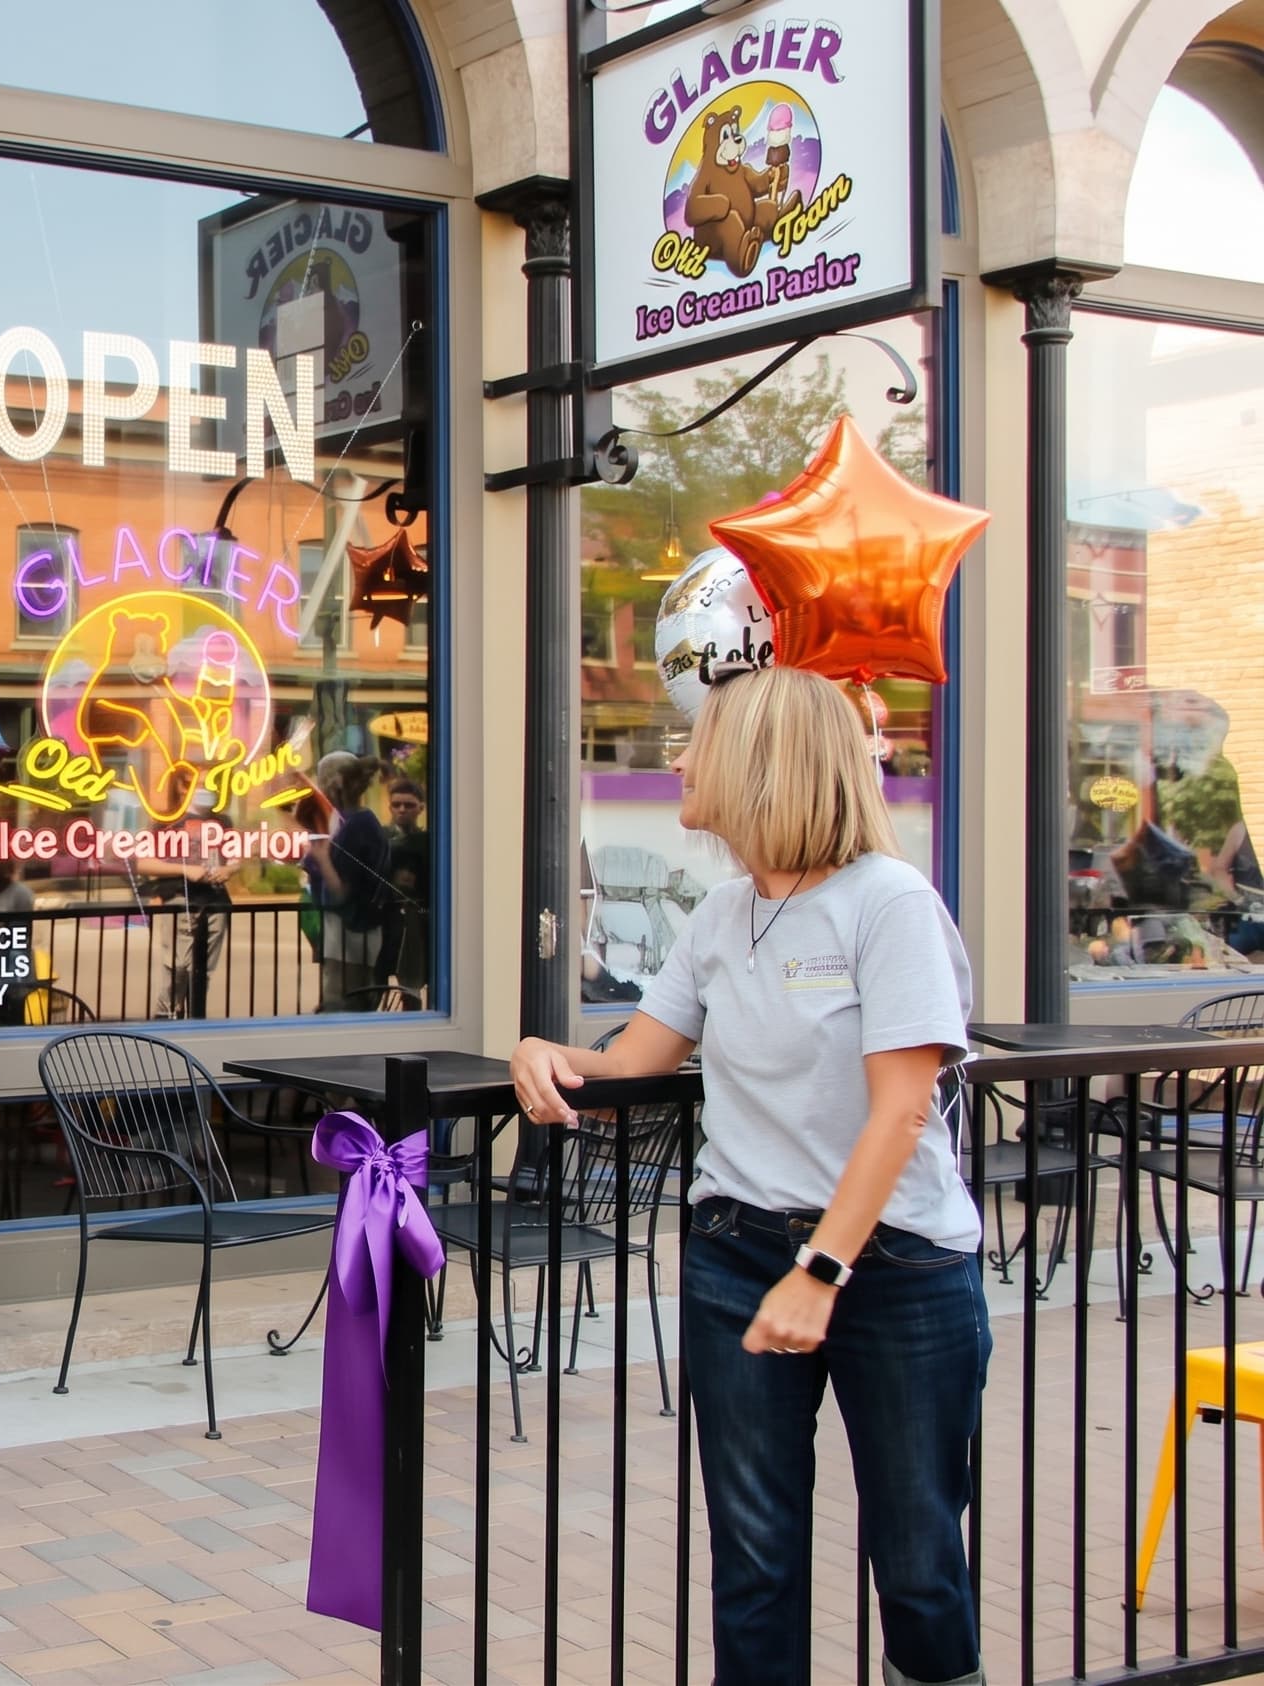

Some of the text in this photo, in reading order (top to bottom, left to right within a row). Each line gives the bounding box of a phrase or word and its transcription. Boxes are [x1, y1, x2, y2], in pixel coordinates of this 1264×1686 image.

[643, 19, 844, 145] GLACIER
[636, 304, 674, 340] Ice
[676, 281, 763, 328] Cream
[15, 527, 302, 638] GLACIER
[25, 738, 302, 813] Old Town
[65, 820, 190, 860] Cream
